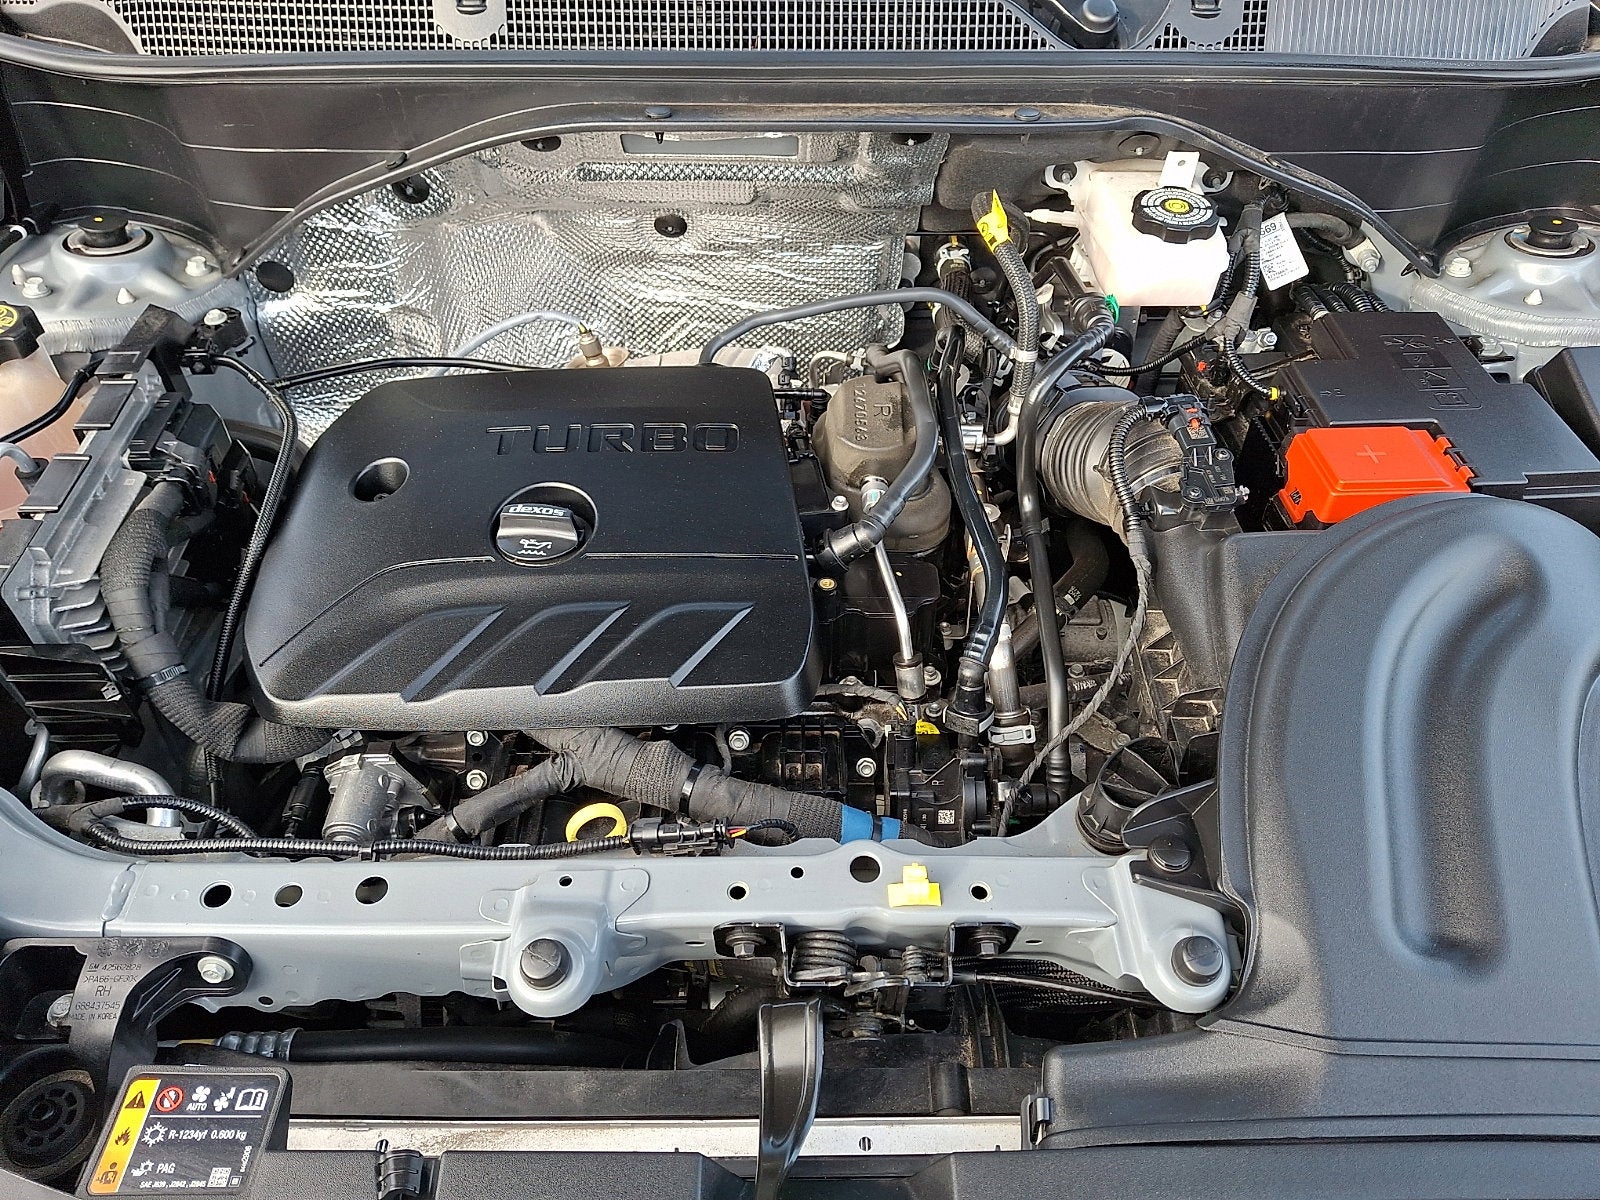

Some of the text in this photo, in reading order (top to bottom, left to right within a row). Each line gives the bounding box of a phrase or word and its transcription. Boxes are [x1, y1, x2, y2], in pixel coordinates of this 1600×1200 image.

[873, 403, 894, 417] R
[486, 422, 740, 456] TURBO
[508, 503, 567, 517] dexos
[94, 985, 112, 997] RH
[88, 1012, 95, 1020] IN
[97, 1012, 117, 1020] KOREA
[186, 1102, 208, 1111] AUTO
[168, 1129, 248, 1141] R-1234yf 0.600 kg
[156, 1162, 176, 1174] PAG
[139, 1180, 152, 1188] SAE
